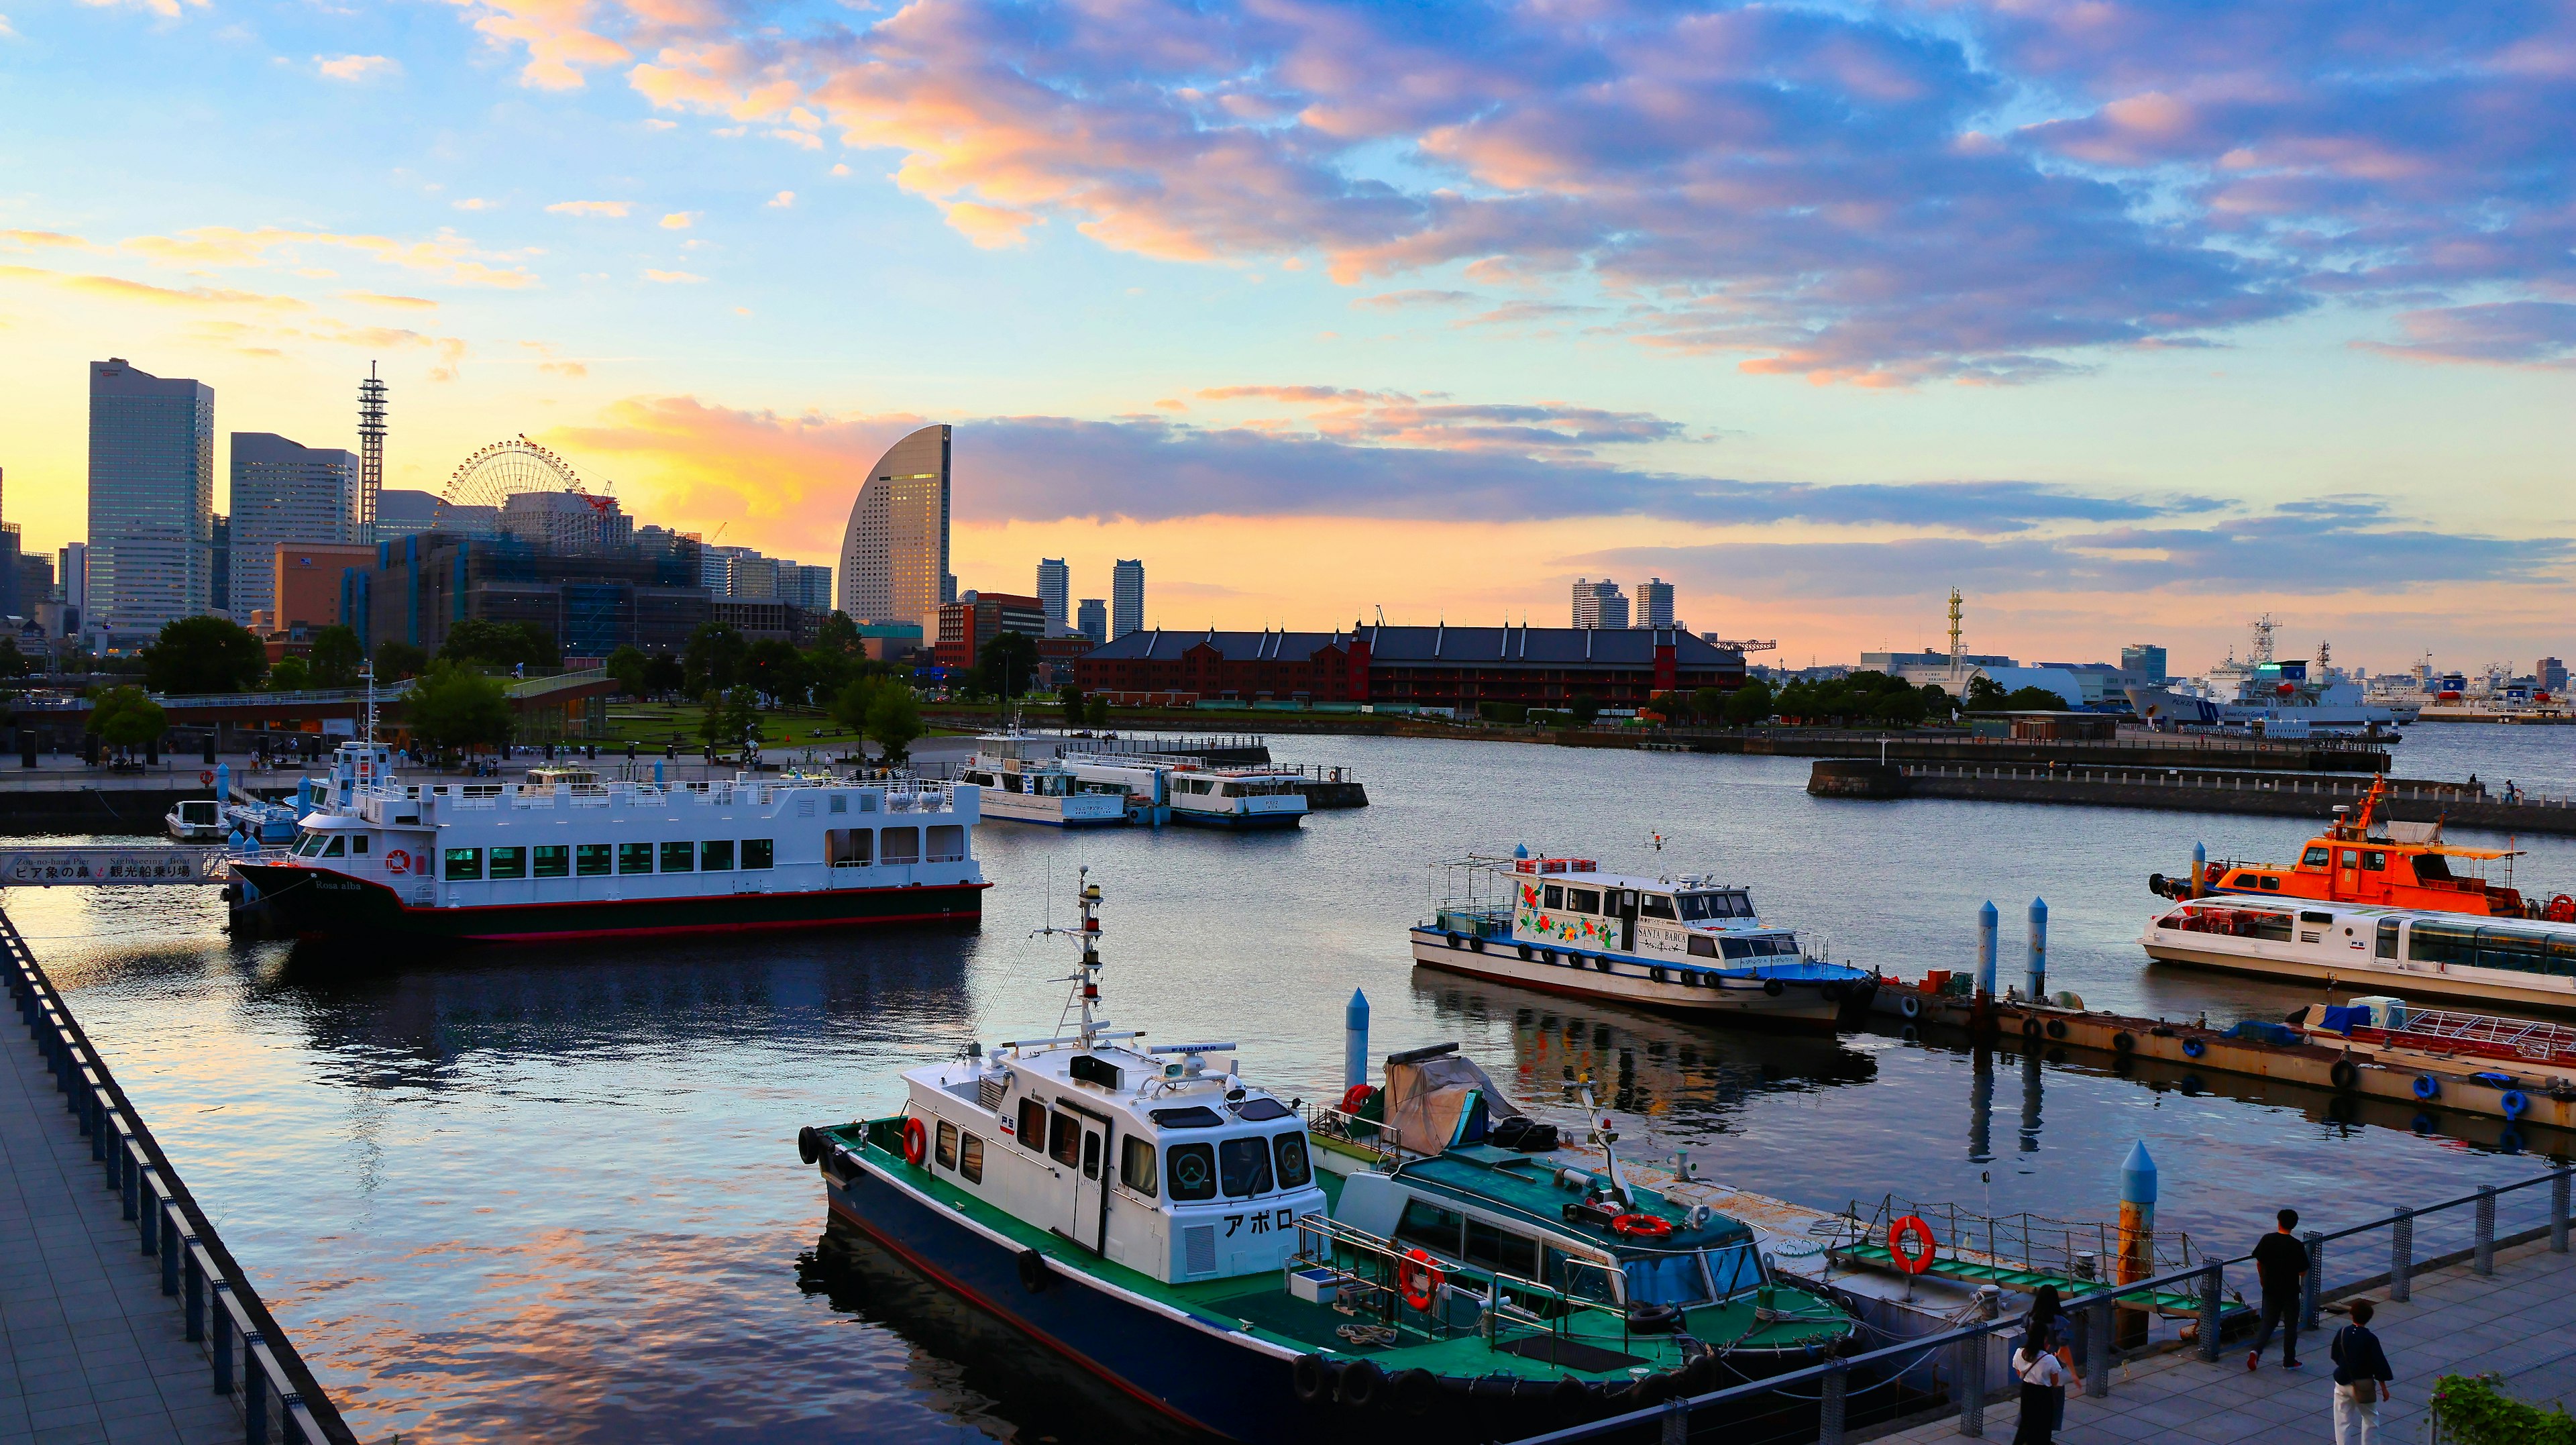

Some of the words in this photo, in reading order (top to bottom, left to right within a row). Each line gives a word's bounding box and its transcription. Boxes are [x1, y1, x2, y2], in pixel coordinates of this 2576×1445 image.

[110, 857, 163, 866] Sightseeing
[16, 867, 90, 878] ピア象の鼻
[110, 866, 191, 877] 観光船乗り場
[315, 880, 338, 890] Rosa
[341, 881, 361, 890] alba
[1638, 927, 1661, 939] SANTA
[1664, 930, 1686, 943] BARCA
[1002, 1115, 1014, 1129] PS
[1080, 1179, 1099, 1195] APOLLO
[1224, 1208, 1293, 1238] アポロ
